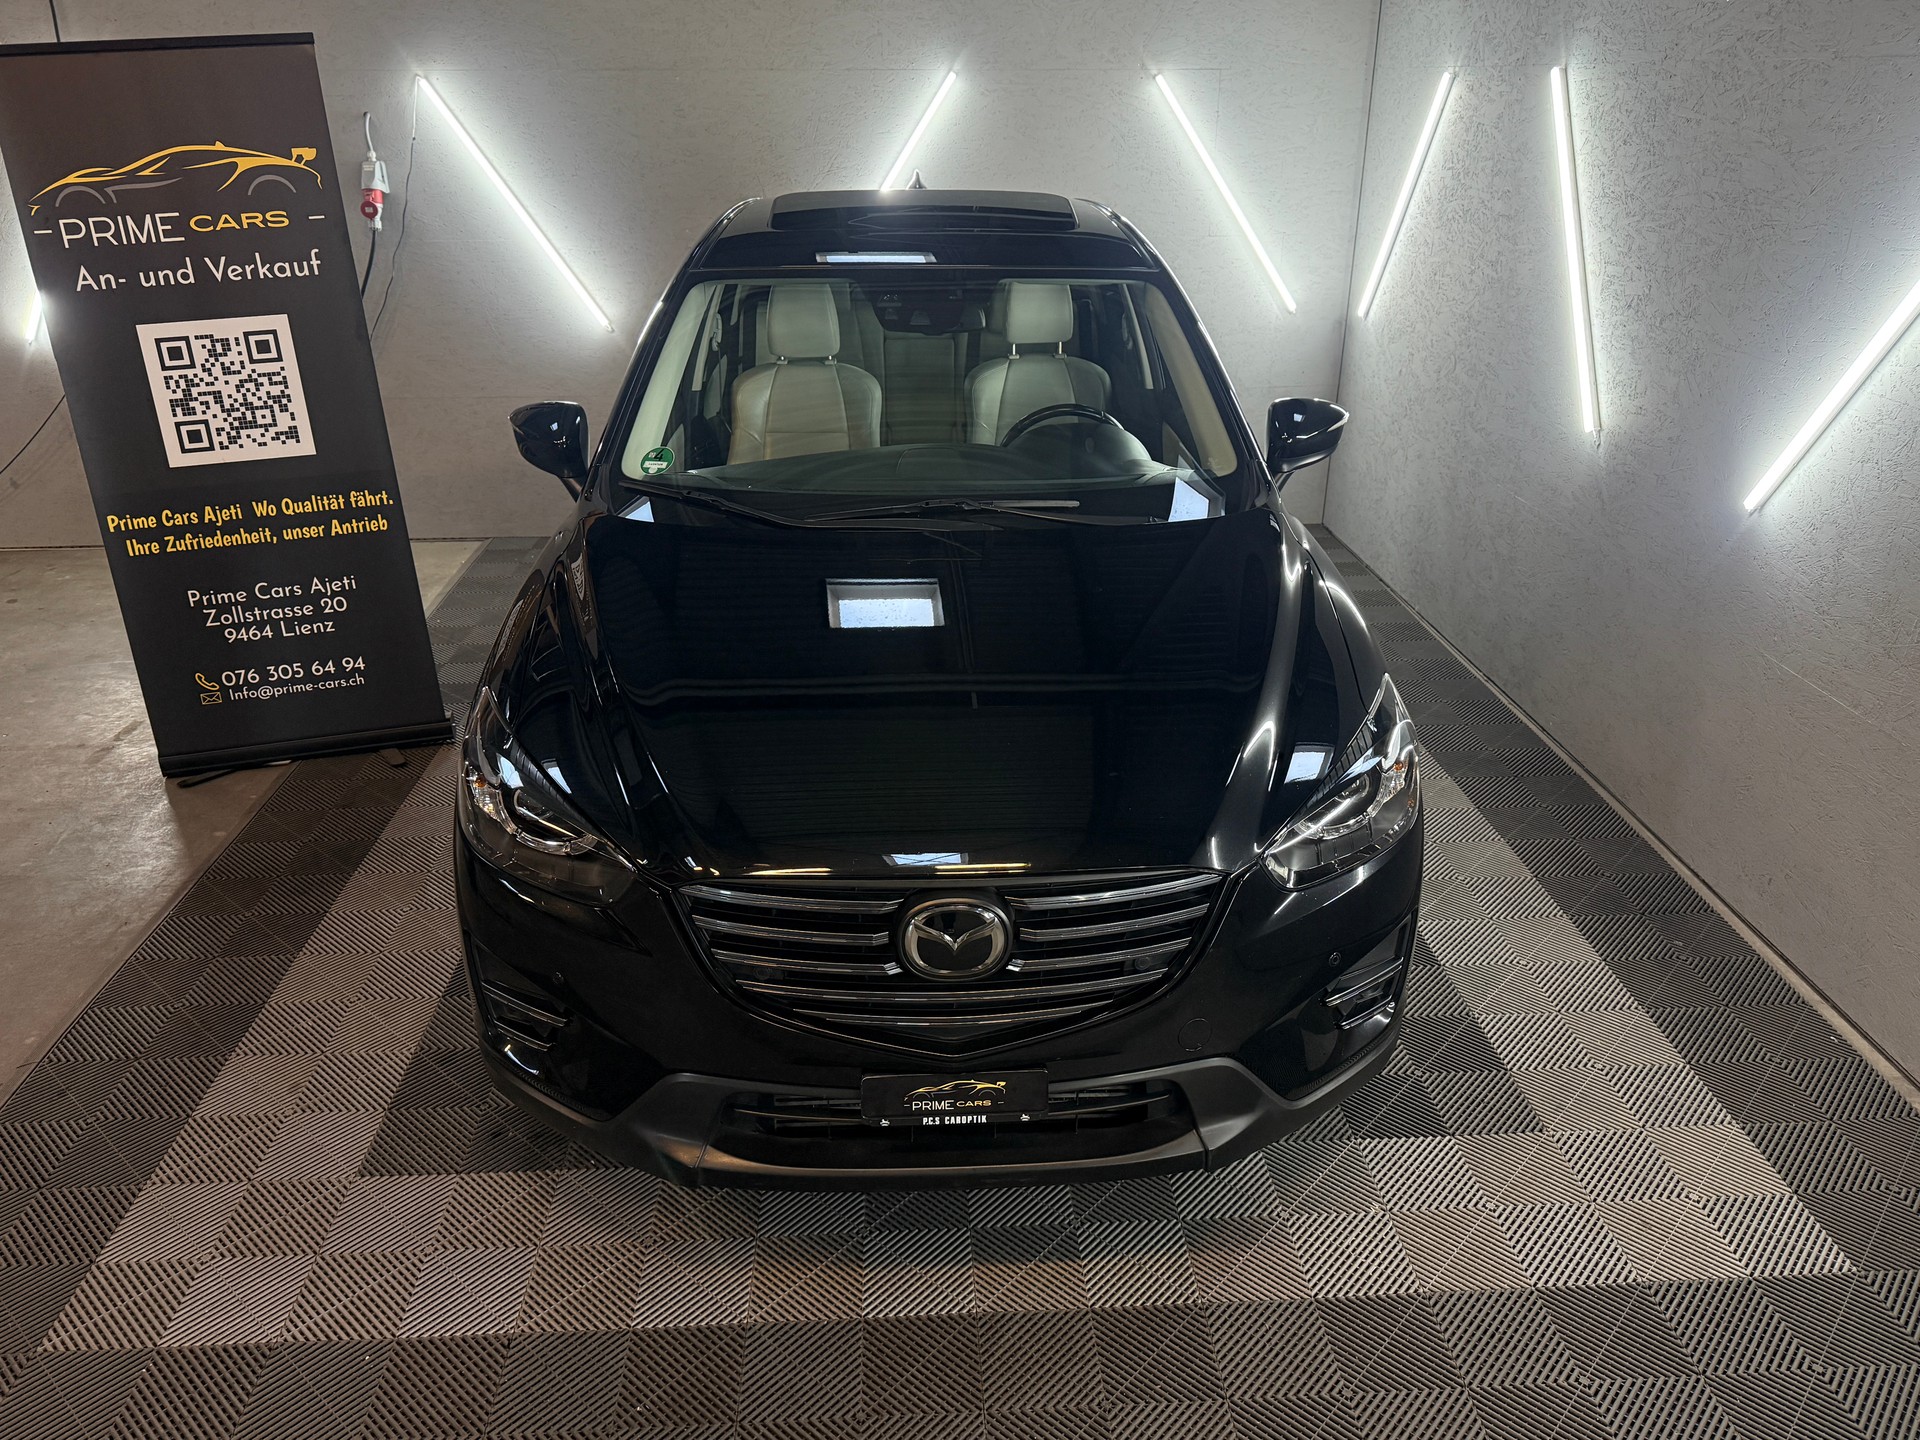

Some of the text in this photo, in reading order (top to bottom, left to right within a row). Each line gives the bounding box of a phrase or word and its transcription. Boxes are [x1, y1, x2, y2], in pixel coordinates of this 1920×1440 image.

[58, 211, 289, 249] PRIME CARS
[76, 249, 321, 291] An- und Verkauf
[654, 449, 664, 461] 4
[106, 490, 393, 533] Prime Cars Ajeti Wo Qualität fährt.
[126, 515, 388, 557] Ihre Zufriedenheit, unser Antrieb
[187, 575, 357, 608] Prime Cars Ajeti
[203, 596, 348, 627] Zollstrasse 20
[224, 620, 335, 644] 9464 Lienz
[221, 656, 365, 687] 076 305 64 94
[229, 674, 365, 701] Info@prime-cars.ch
[912, 1100, 954, 1111] PRIME
[945, 1115, 987, 1124] CAROPTIK
